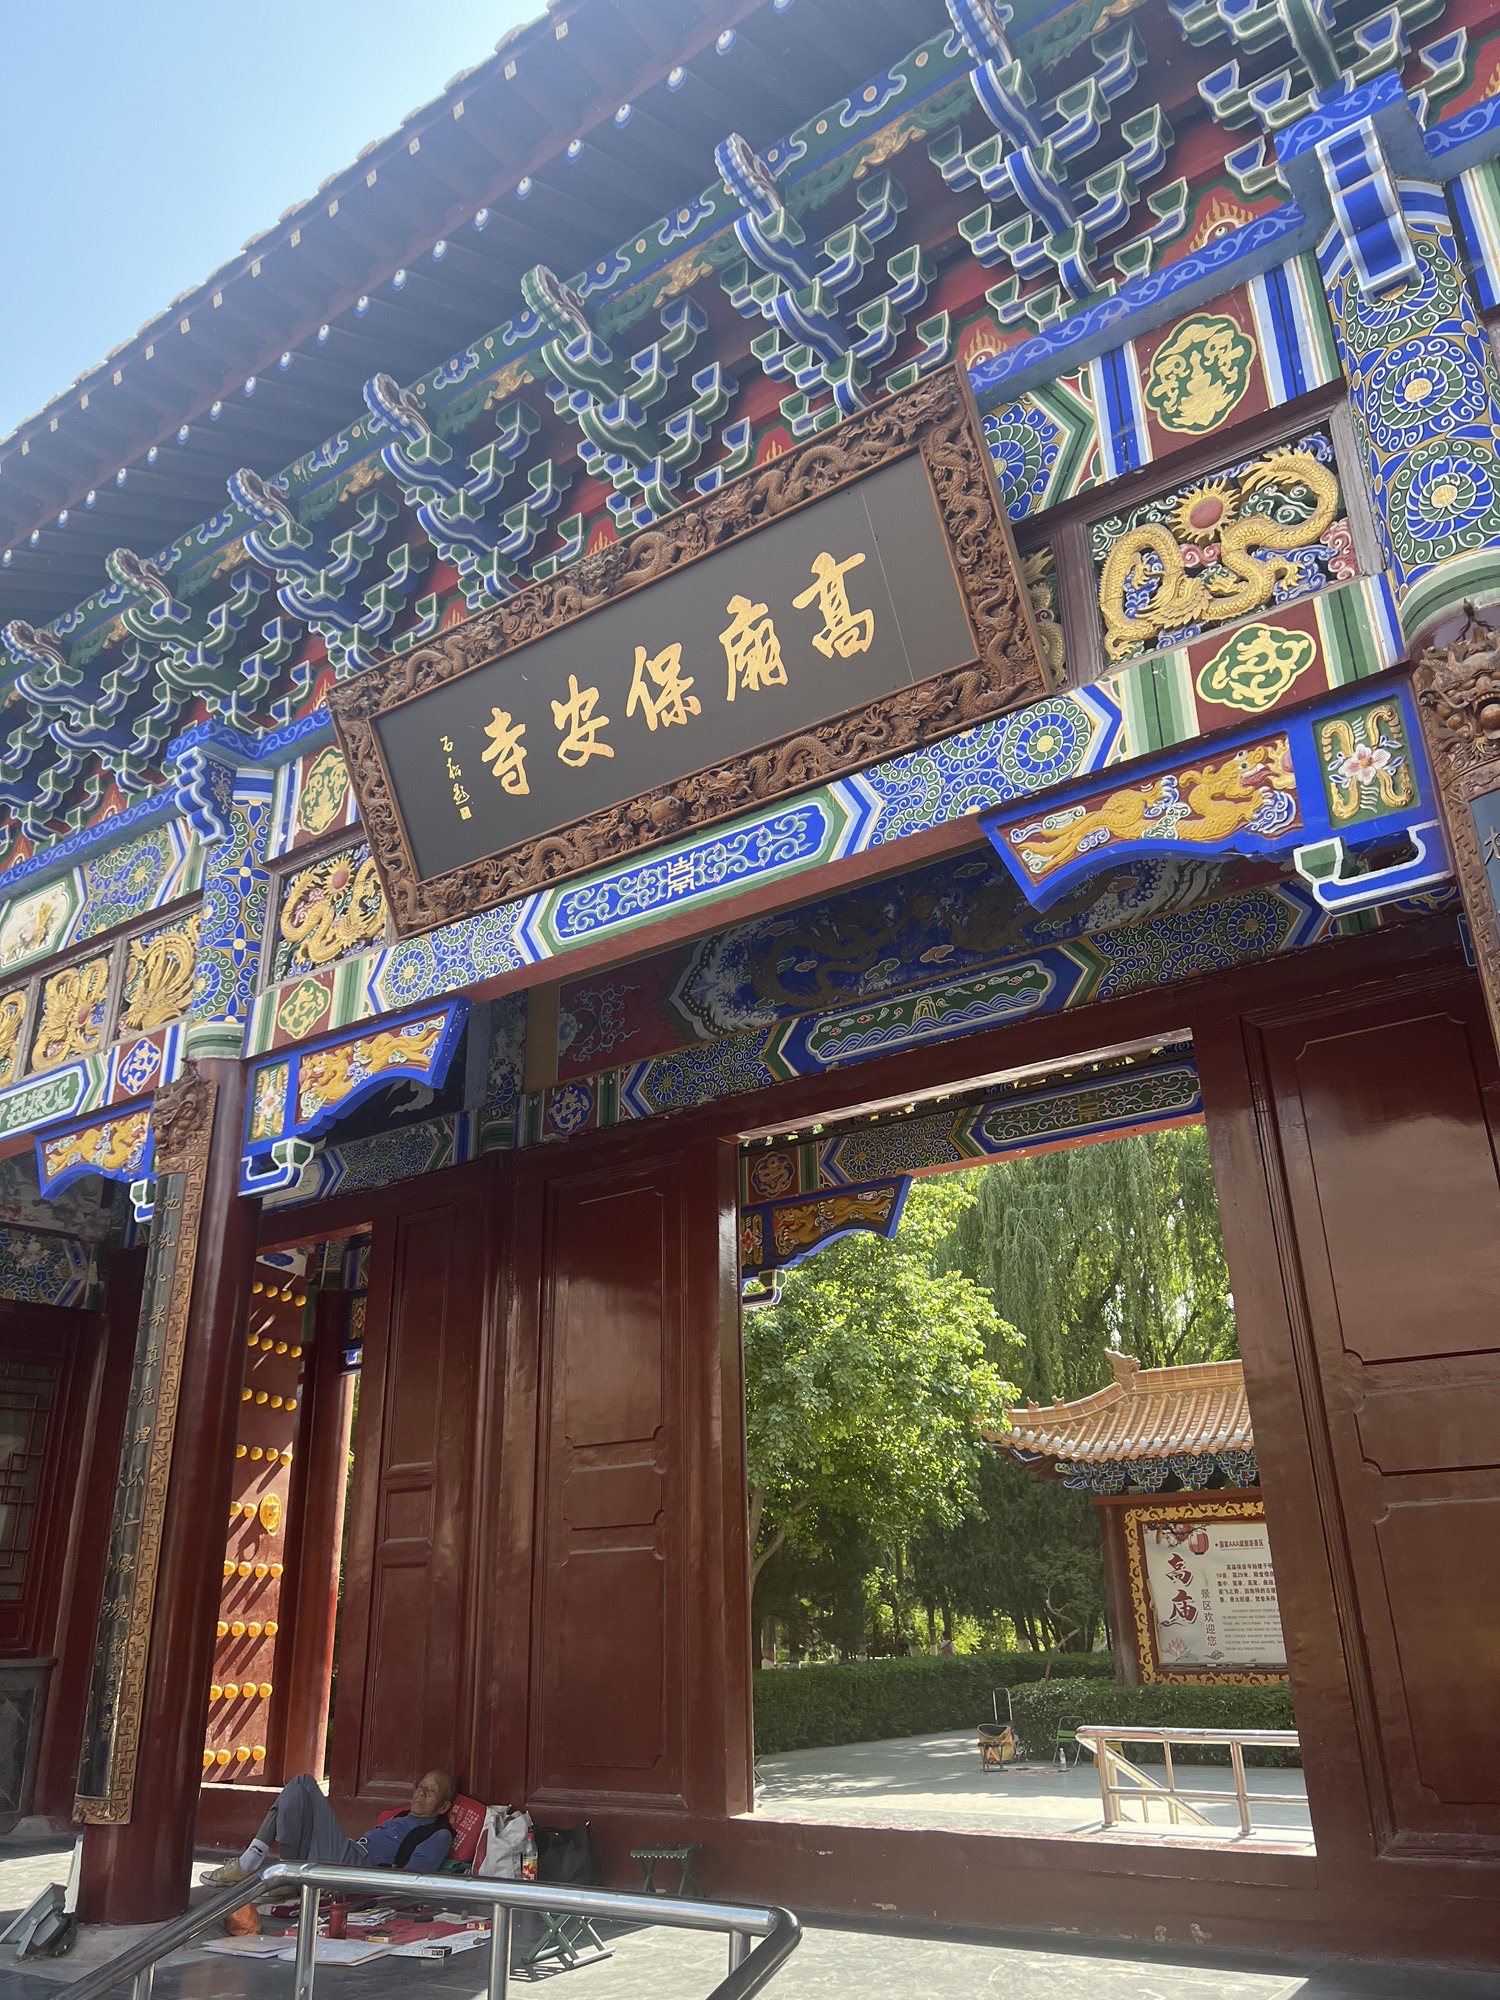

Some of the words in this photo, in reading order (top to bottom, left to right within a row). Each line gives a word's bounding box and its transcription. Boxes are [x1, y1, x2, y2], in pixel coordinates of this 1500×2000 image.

[1165, 1553, 1198, 1624] 高庙
[1200, 1589, 1218, 1647] 景区欢迎您
